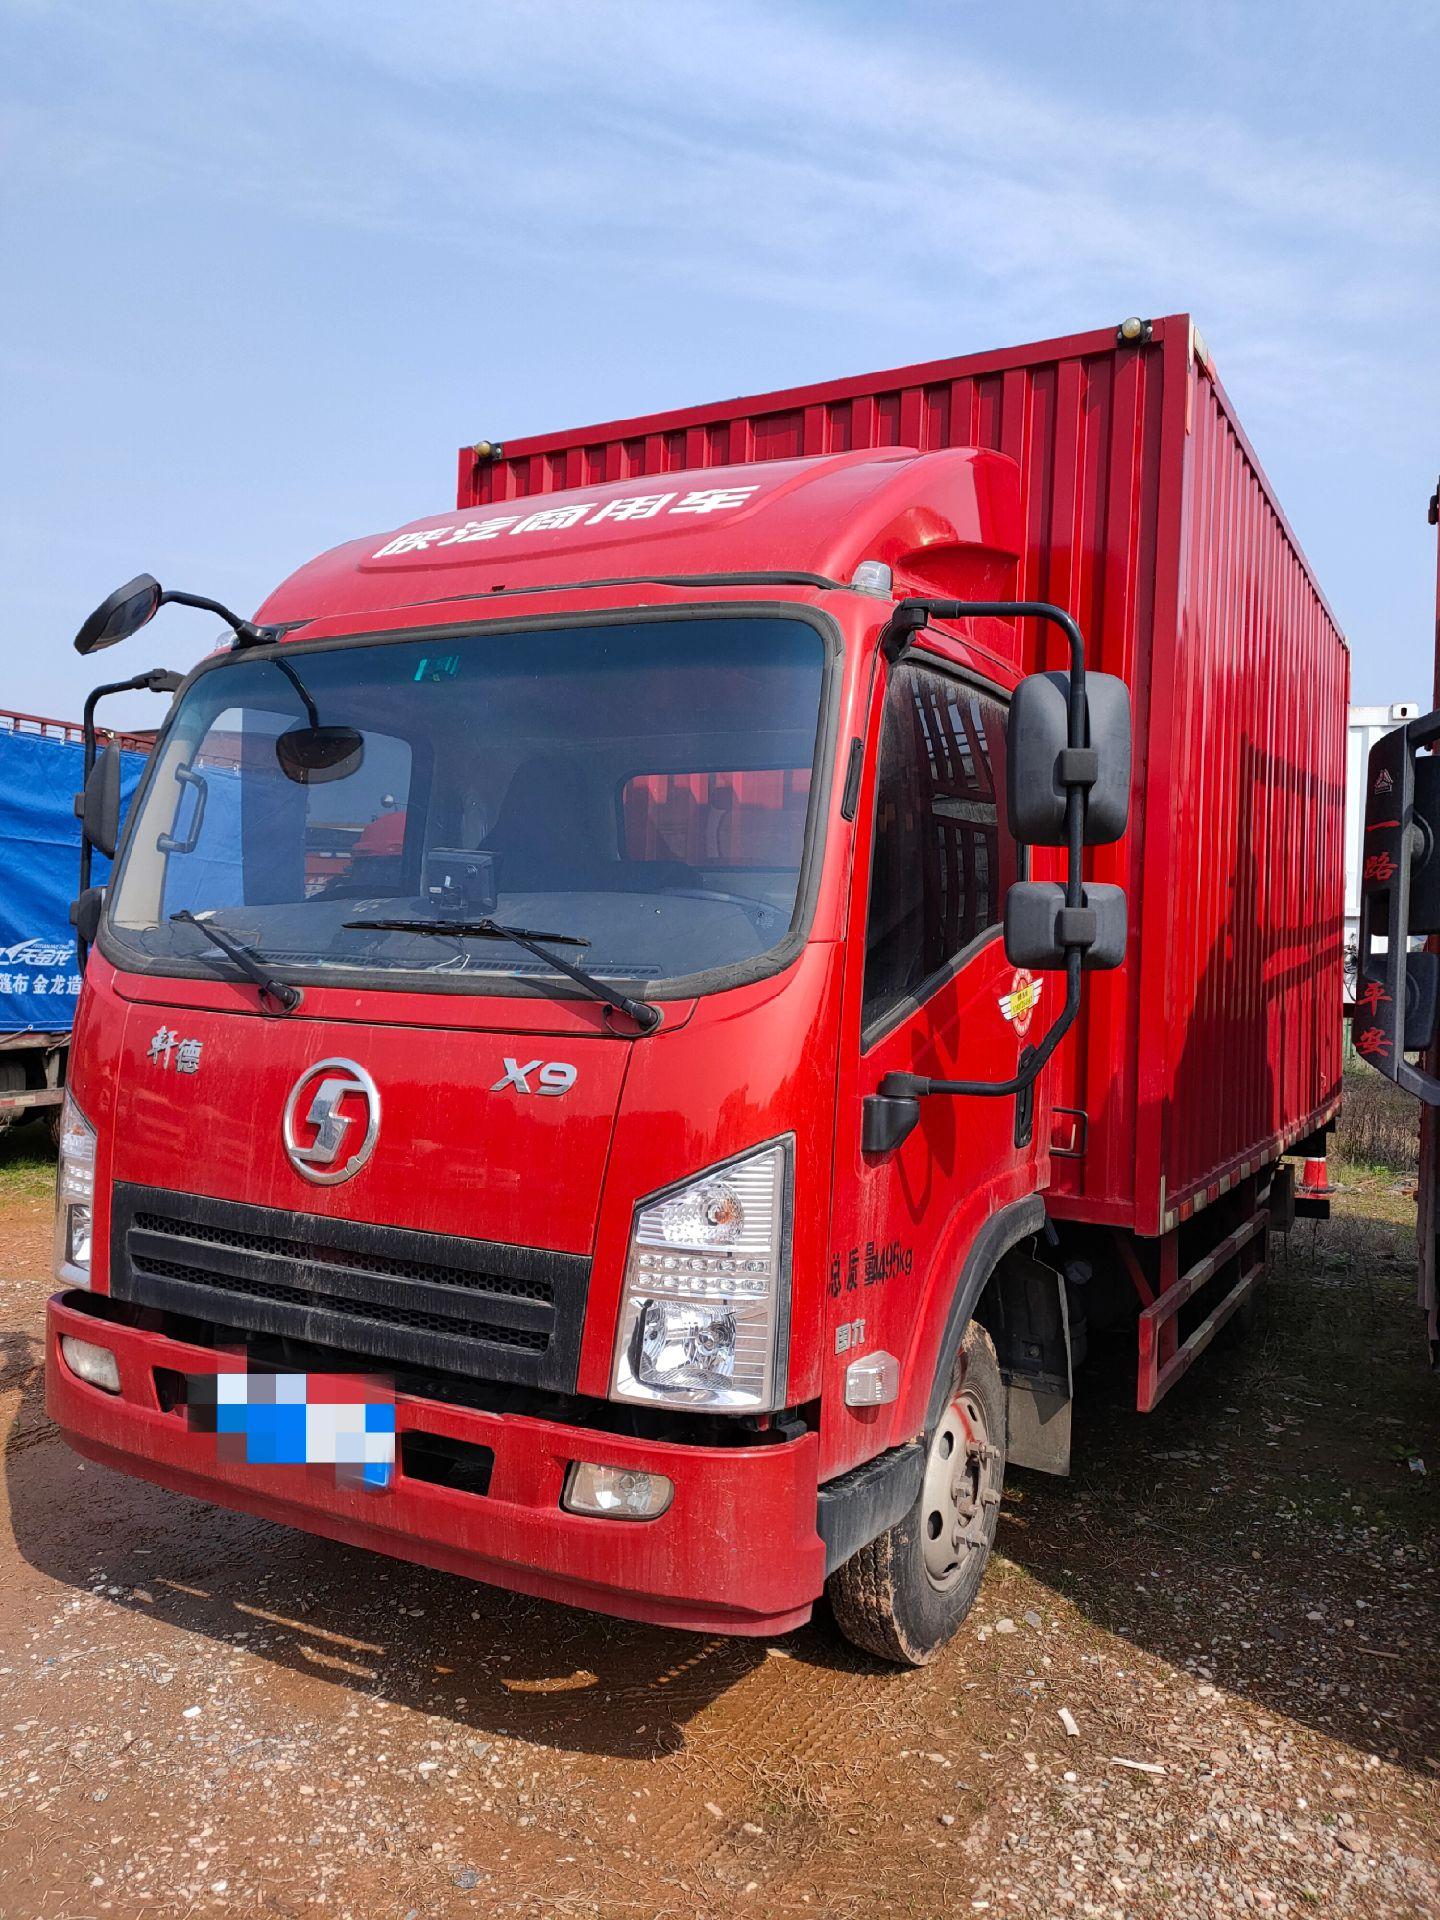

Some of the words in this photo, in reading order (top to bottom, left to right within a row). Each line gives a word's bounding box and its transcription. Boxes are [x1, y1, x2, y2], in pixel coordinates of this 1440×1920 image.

[371, 484, 761, 559] 陕汽商用车
[489, 1057, 578, 1096] X9
[834, 1318, 867, 1355] 国六
